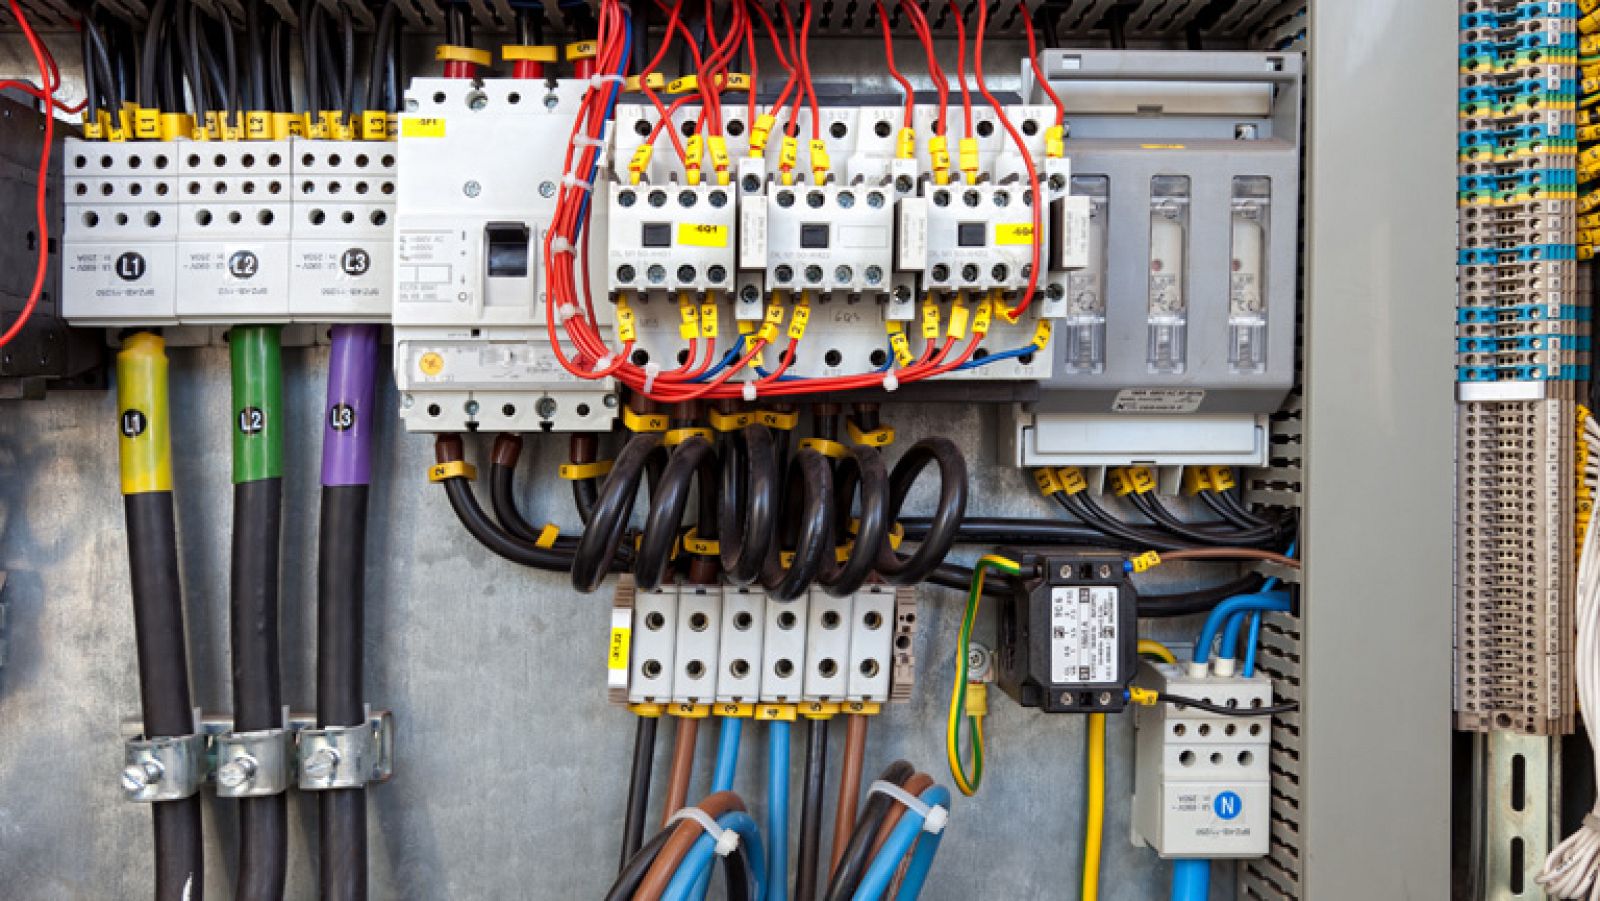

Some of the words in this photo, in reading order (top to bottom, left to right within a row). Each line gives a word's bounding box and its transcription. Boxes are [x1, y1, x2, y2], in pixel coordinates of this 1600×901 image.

[140, 118, 155, 132] L1
[249, 118, 264, 132] L2
[370, 118, 385, 132] L3
[694, 225, 718, 234] -6Q1
[121, 256, 141, 276] L1
[233, 254, 255, 274] L2
[345, 252, 366, 272] L3
[124, 413, 141, 433] L1
[240, 411, 262, 431] L2
[333, 408, 351, 427] L3
[681, 704, 694, 712] 2
[1222, 796, 1234, 815] N
